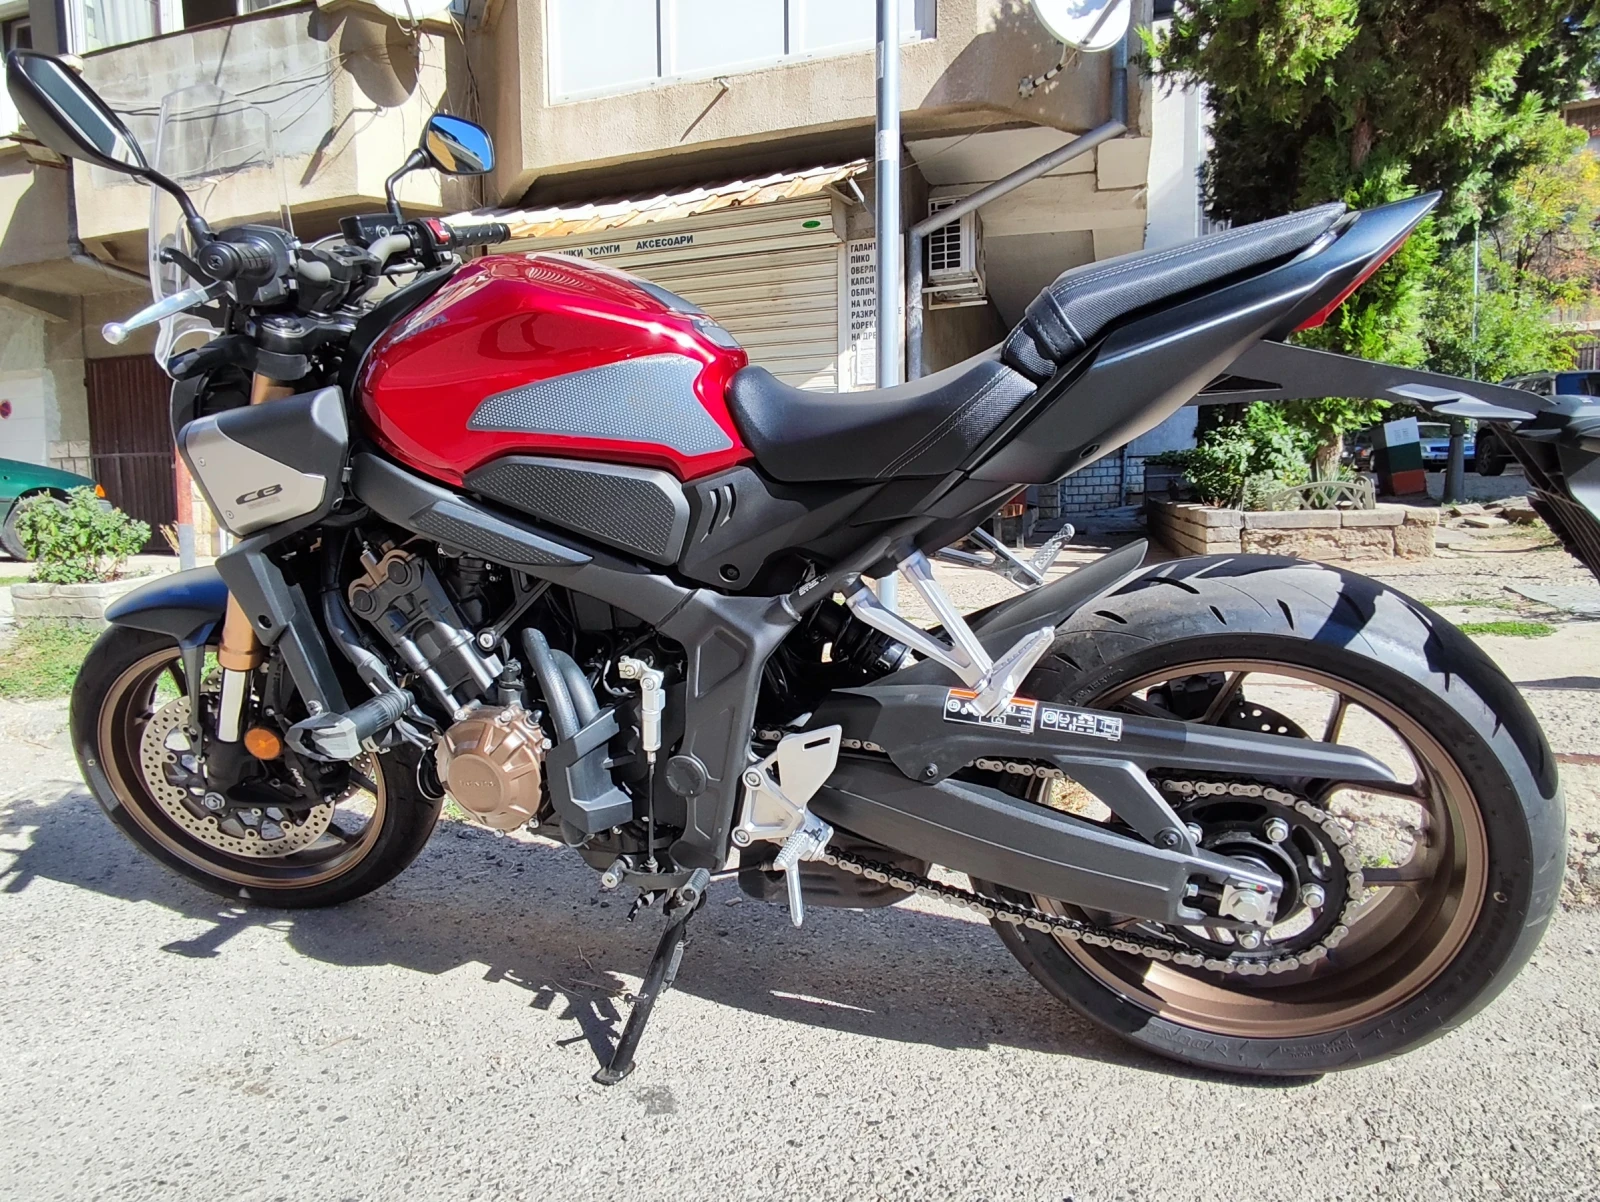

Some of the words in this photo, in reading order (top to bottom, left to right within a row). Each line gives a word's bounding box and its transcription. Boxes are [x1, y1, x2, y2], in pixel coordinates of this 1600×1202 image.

[587, 244, 620, 255] УСЛУГИ
[636, 234, 694, 250] АКСЕСОАРИ
[850, 276, 875, 286] КАПСИ
[851, 287, 876, 297] ОБЛИЧ
[851, 299, 861, 308] НА
[851, 332, 861, 341] НА
[235, 484, 283, 505] CB
